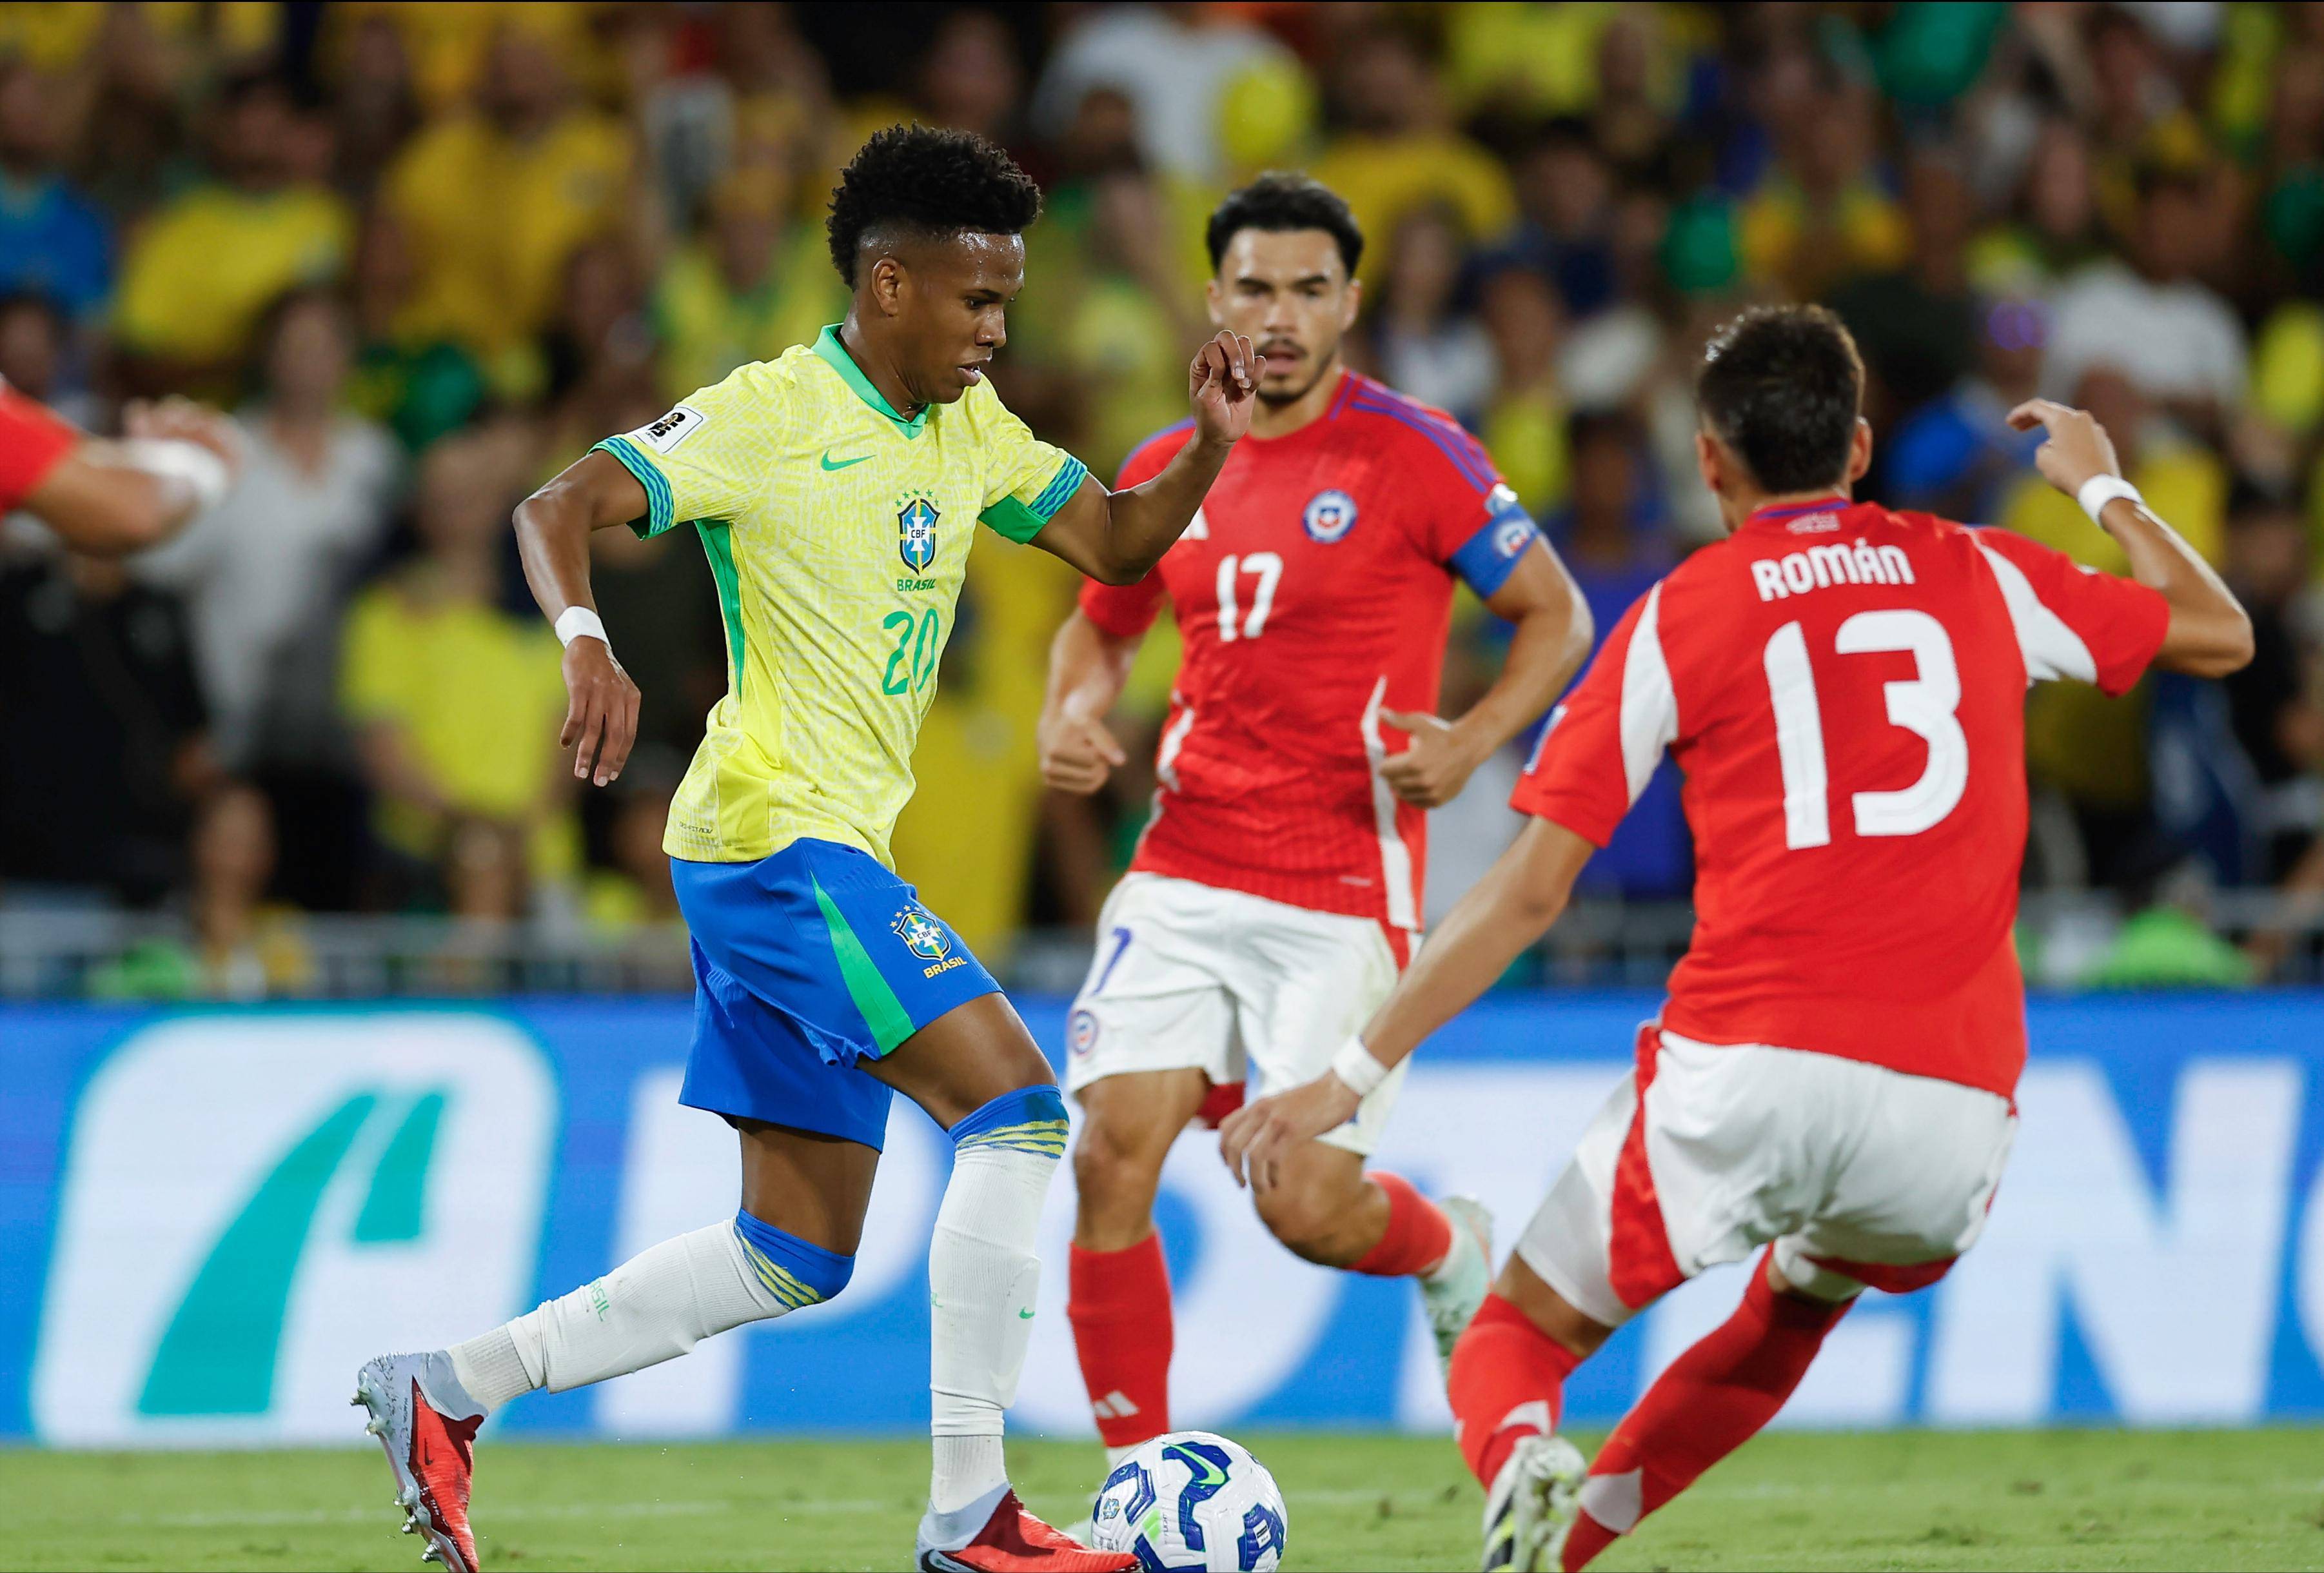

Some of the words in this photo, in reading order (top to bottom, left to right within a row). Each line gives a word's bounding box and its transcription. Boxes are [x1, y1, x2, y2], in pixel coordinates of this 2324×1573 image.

[911, 529, 925, 539] CBF
[897, 579, 936, 591] BRASIL
[1751, 537, 1915, 602] ROMÁN
[1216, 552, 1284, 642] 17
[882, 609, 939, 695] 20
[1764, 608, 1969, 850] 13
[917, 929, 932, 940] CBF
[923, 956, 967, 979] BRASIL
